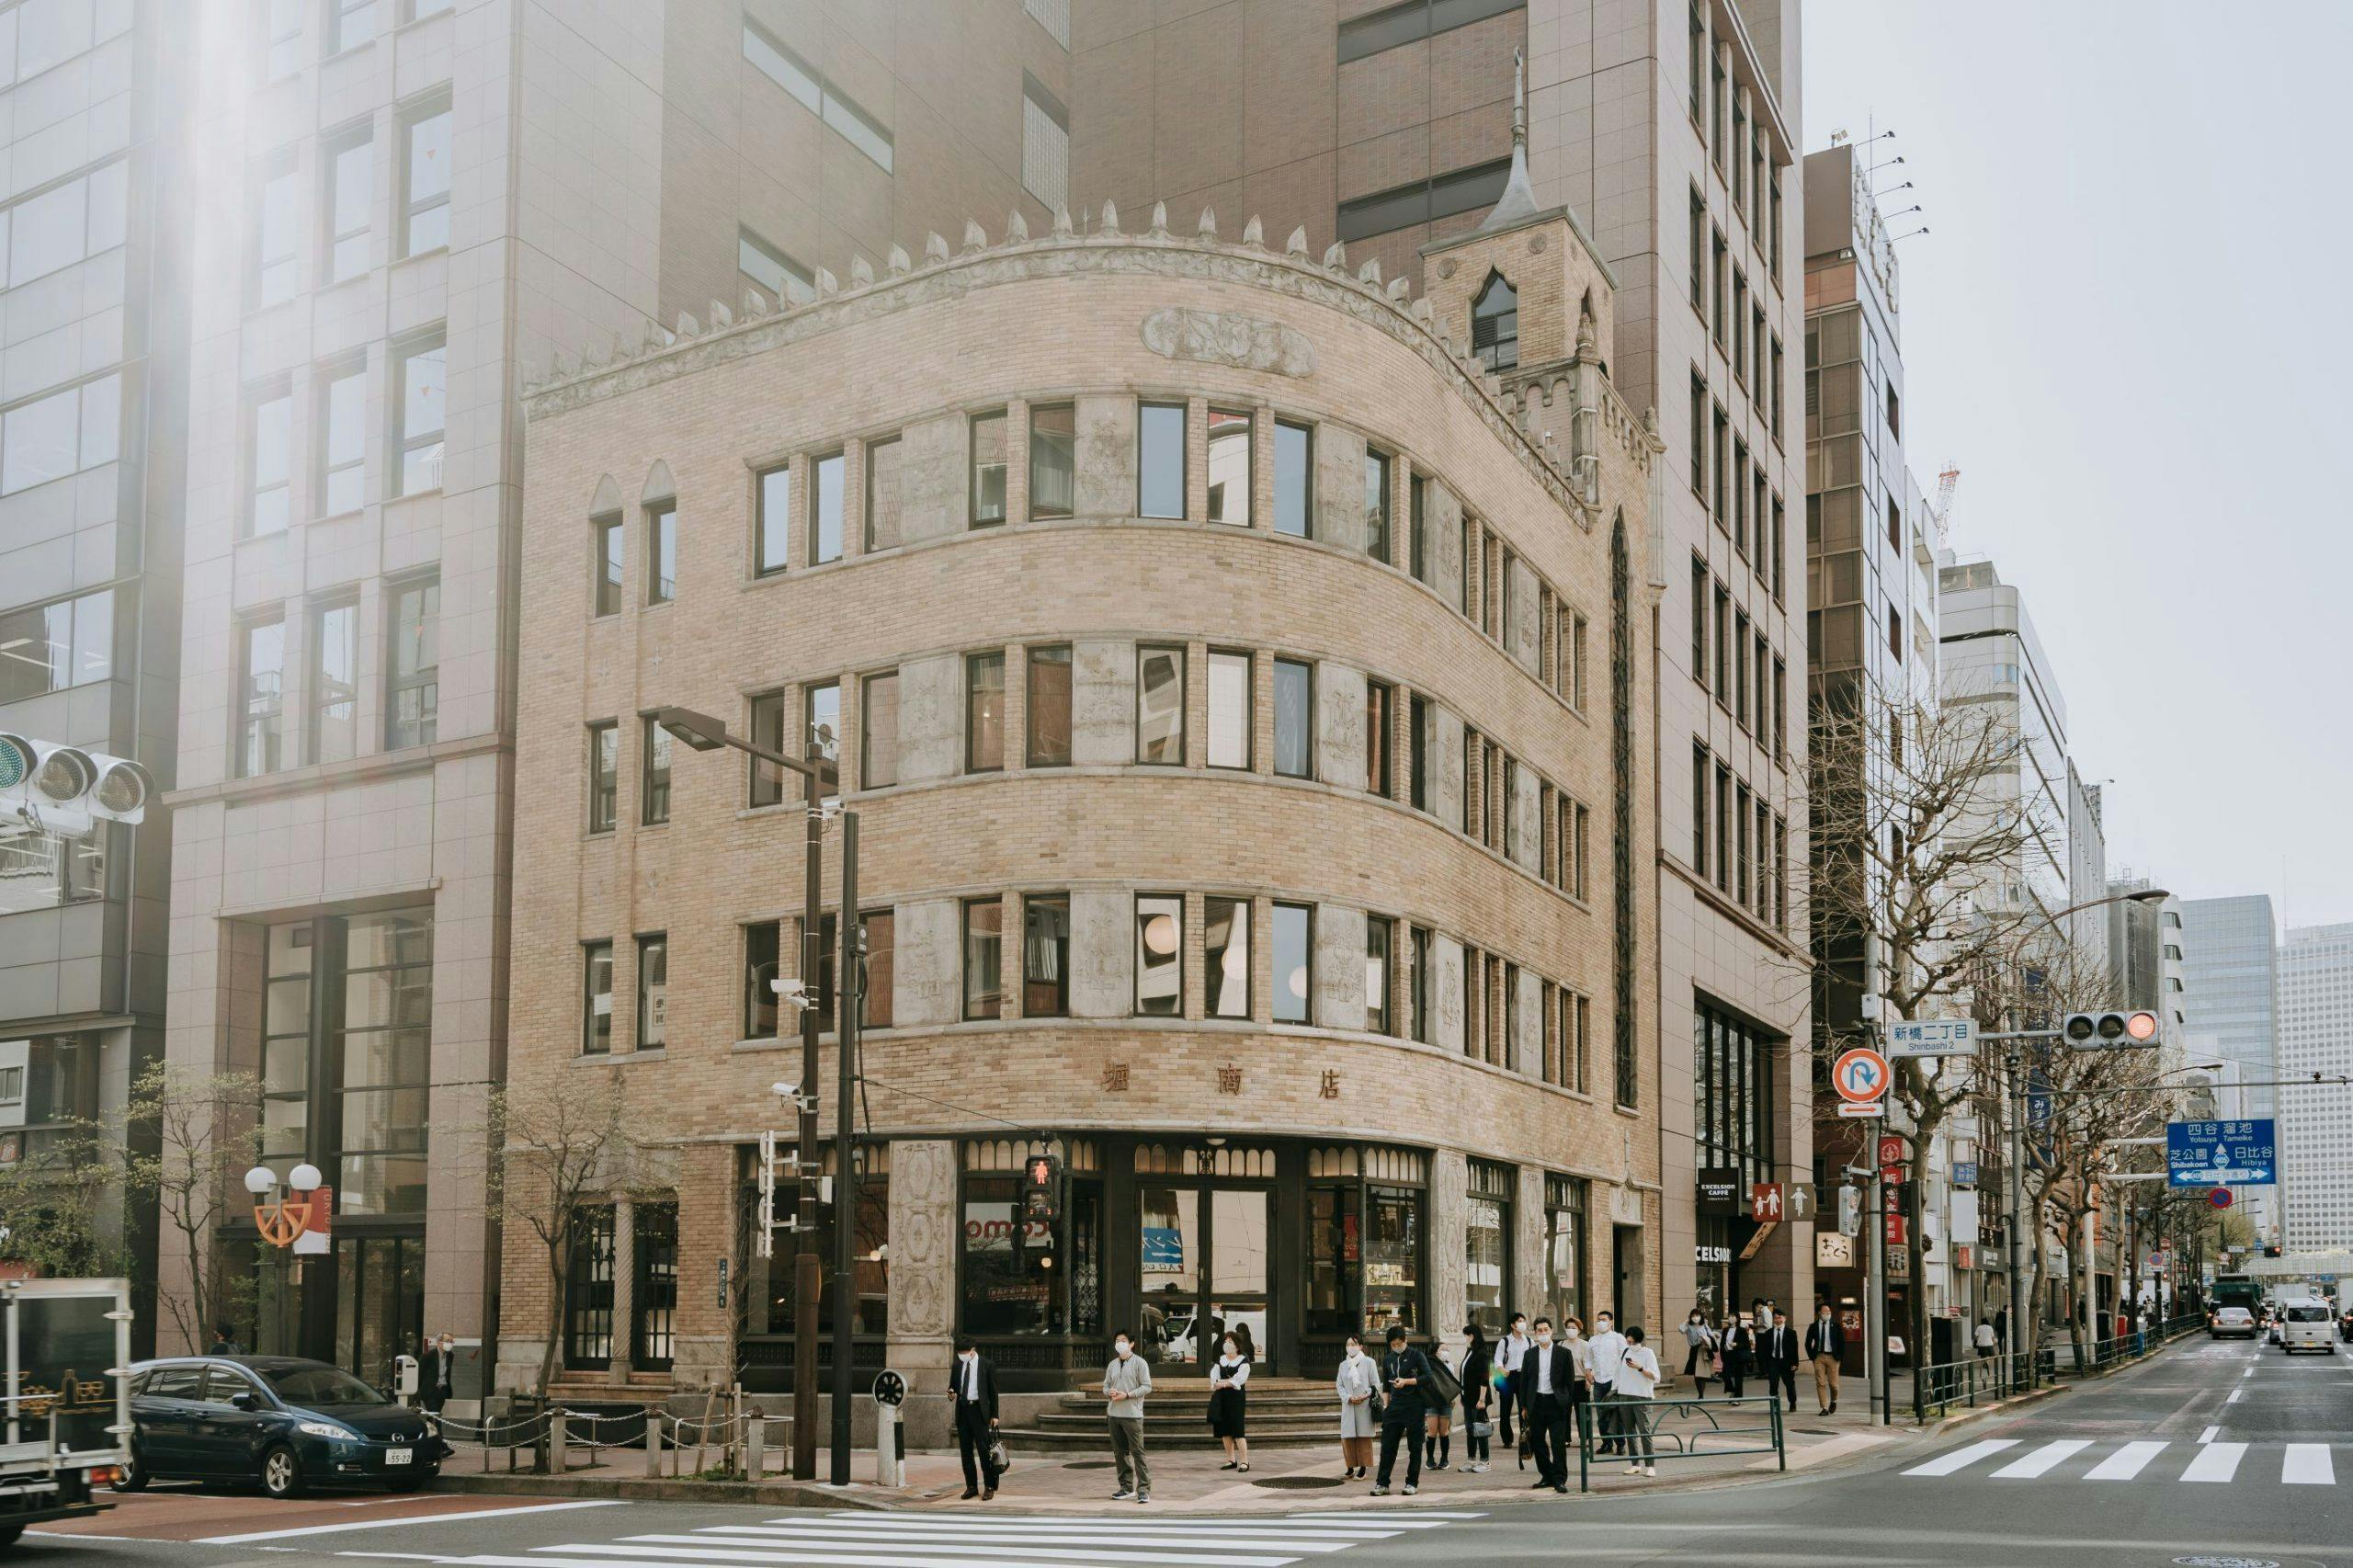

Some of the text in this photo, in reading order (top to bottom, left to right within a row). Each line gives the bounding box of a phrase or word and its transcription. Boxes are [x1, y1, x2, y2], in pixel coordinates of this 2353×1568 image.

[1893, 1024, 1967, 1040] 新橋二丁目
[1908, 1041, 1955, 1051] Shinbashi 2
[1103, 1062, 1341, 1100] 堀商店
[2188, 1122, 2253, 1135] 四谷 溜池
[2169, 1148, 2208, 1161] 芝公園
[2234, 1146, 2273, 1159] 日比谷
[2241, 1159, 2268, 1167] Hibiya
[391, 1454, 412, 1463] 55-22
